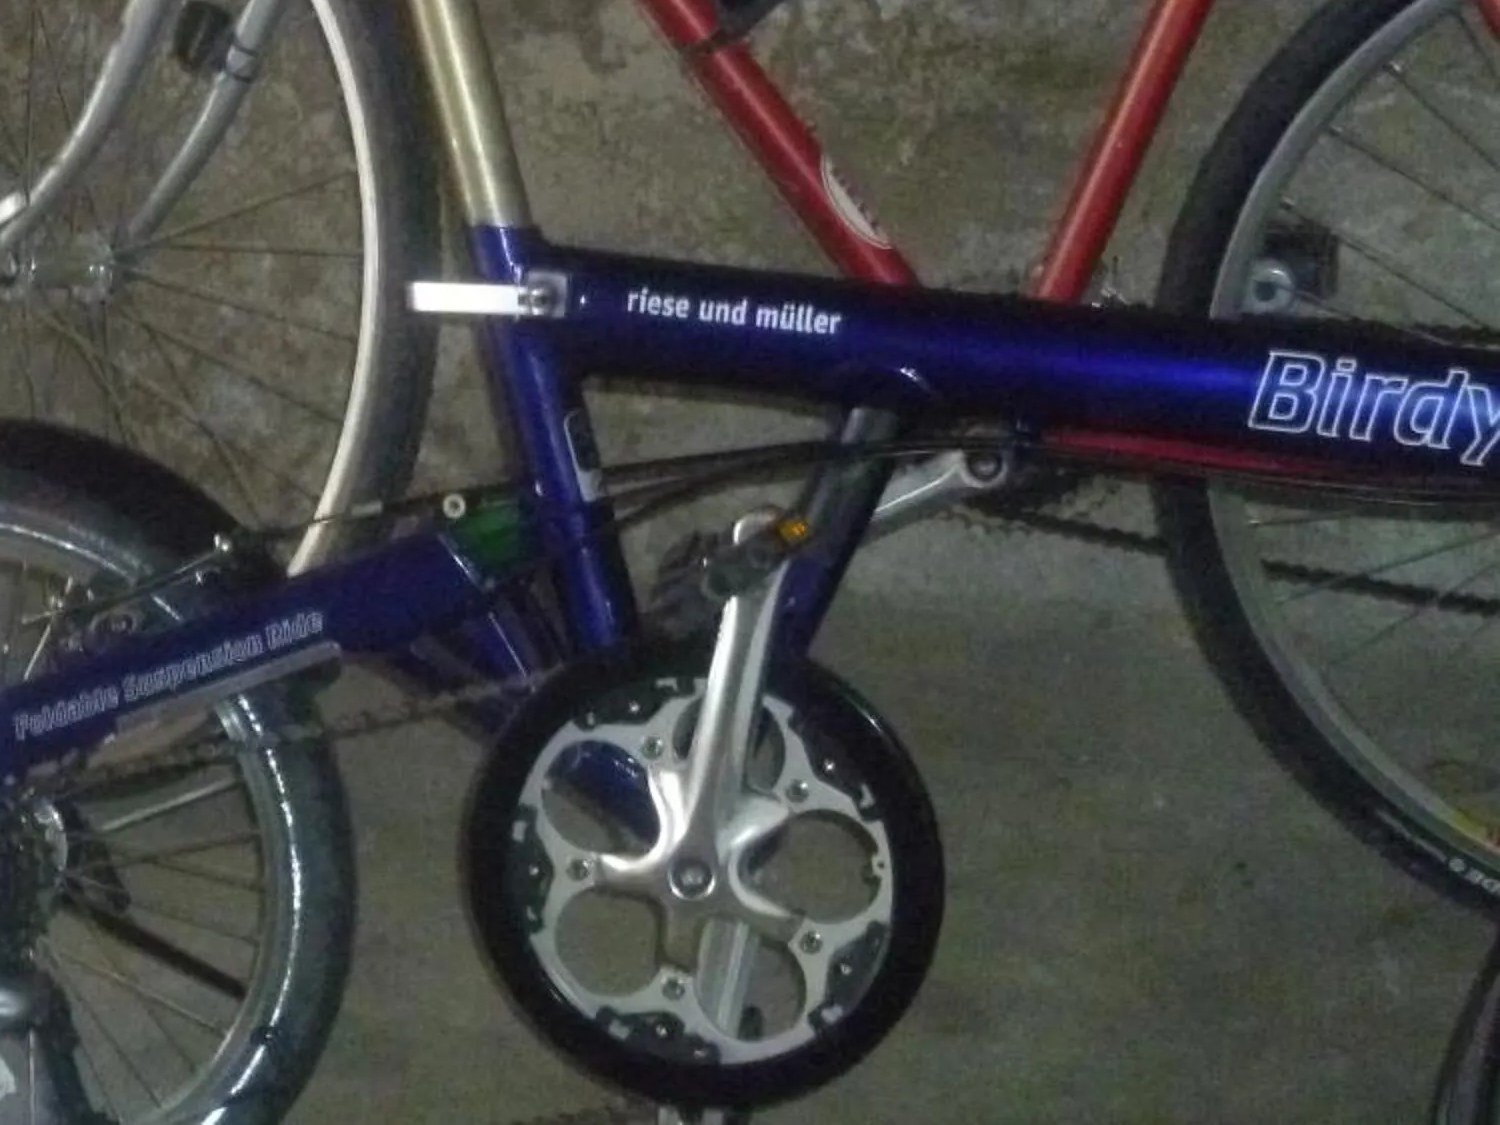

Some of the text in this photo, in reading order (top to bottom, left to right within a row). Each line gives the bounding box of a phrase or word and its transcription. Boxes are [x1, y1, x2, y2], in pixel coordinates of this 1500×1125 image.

[626, 286, 842, 335] riese und müller
[1248, 348, 1500, 467] Birdy
[13, 685, 120, 742] Foldable
[122, 631, 266, 702] Suspension
